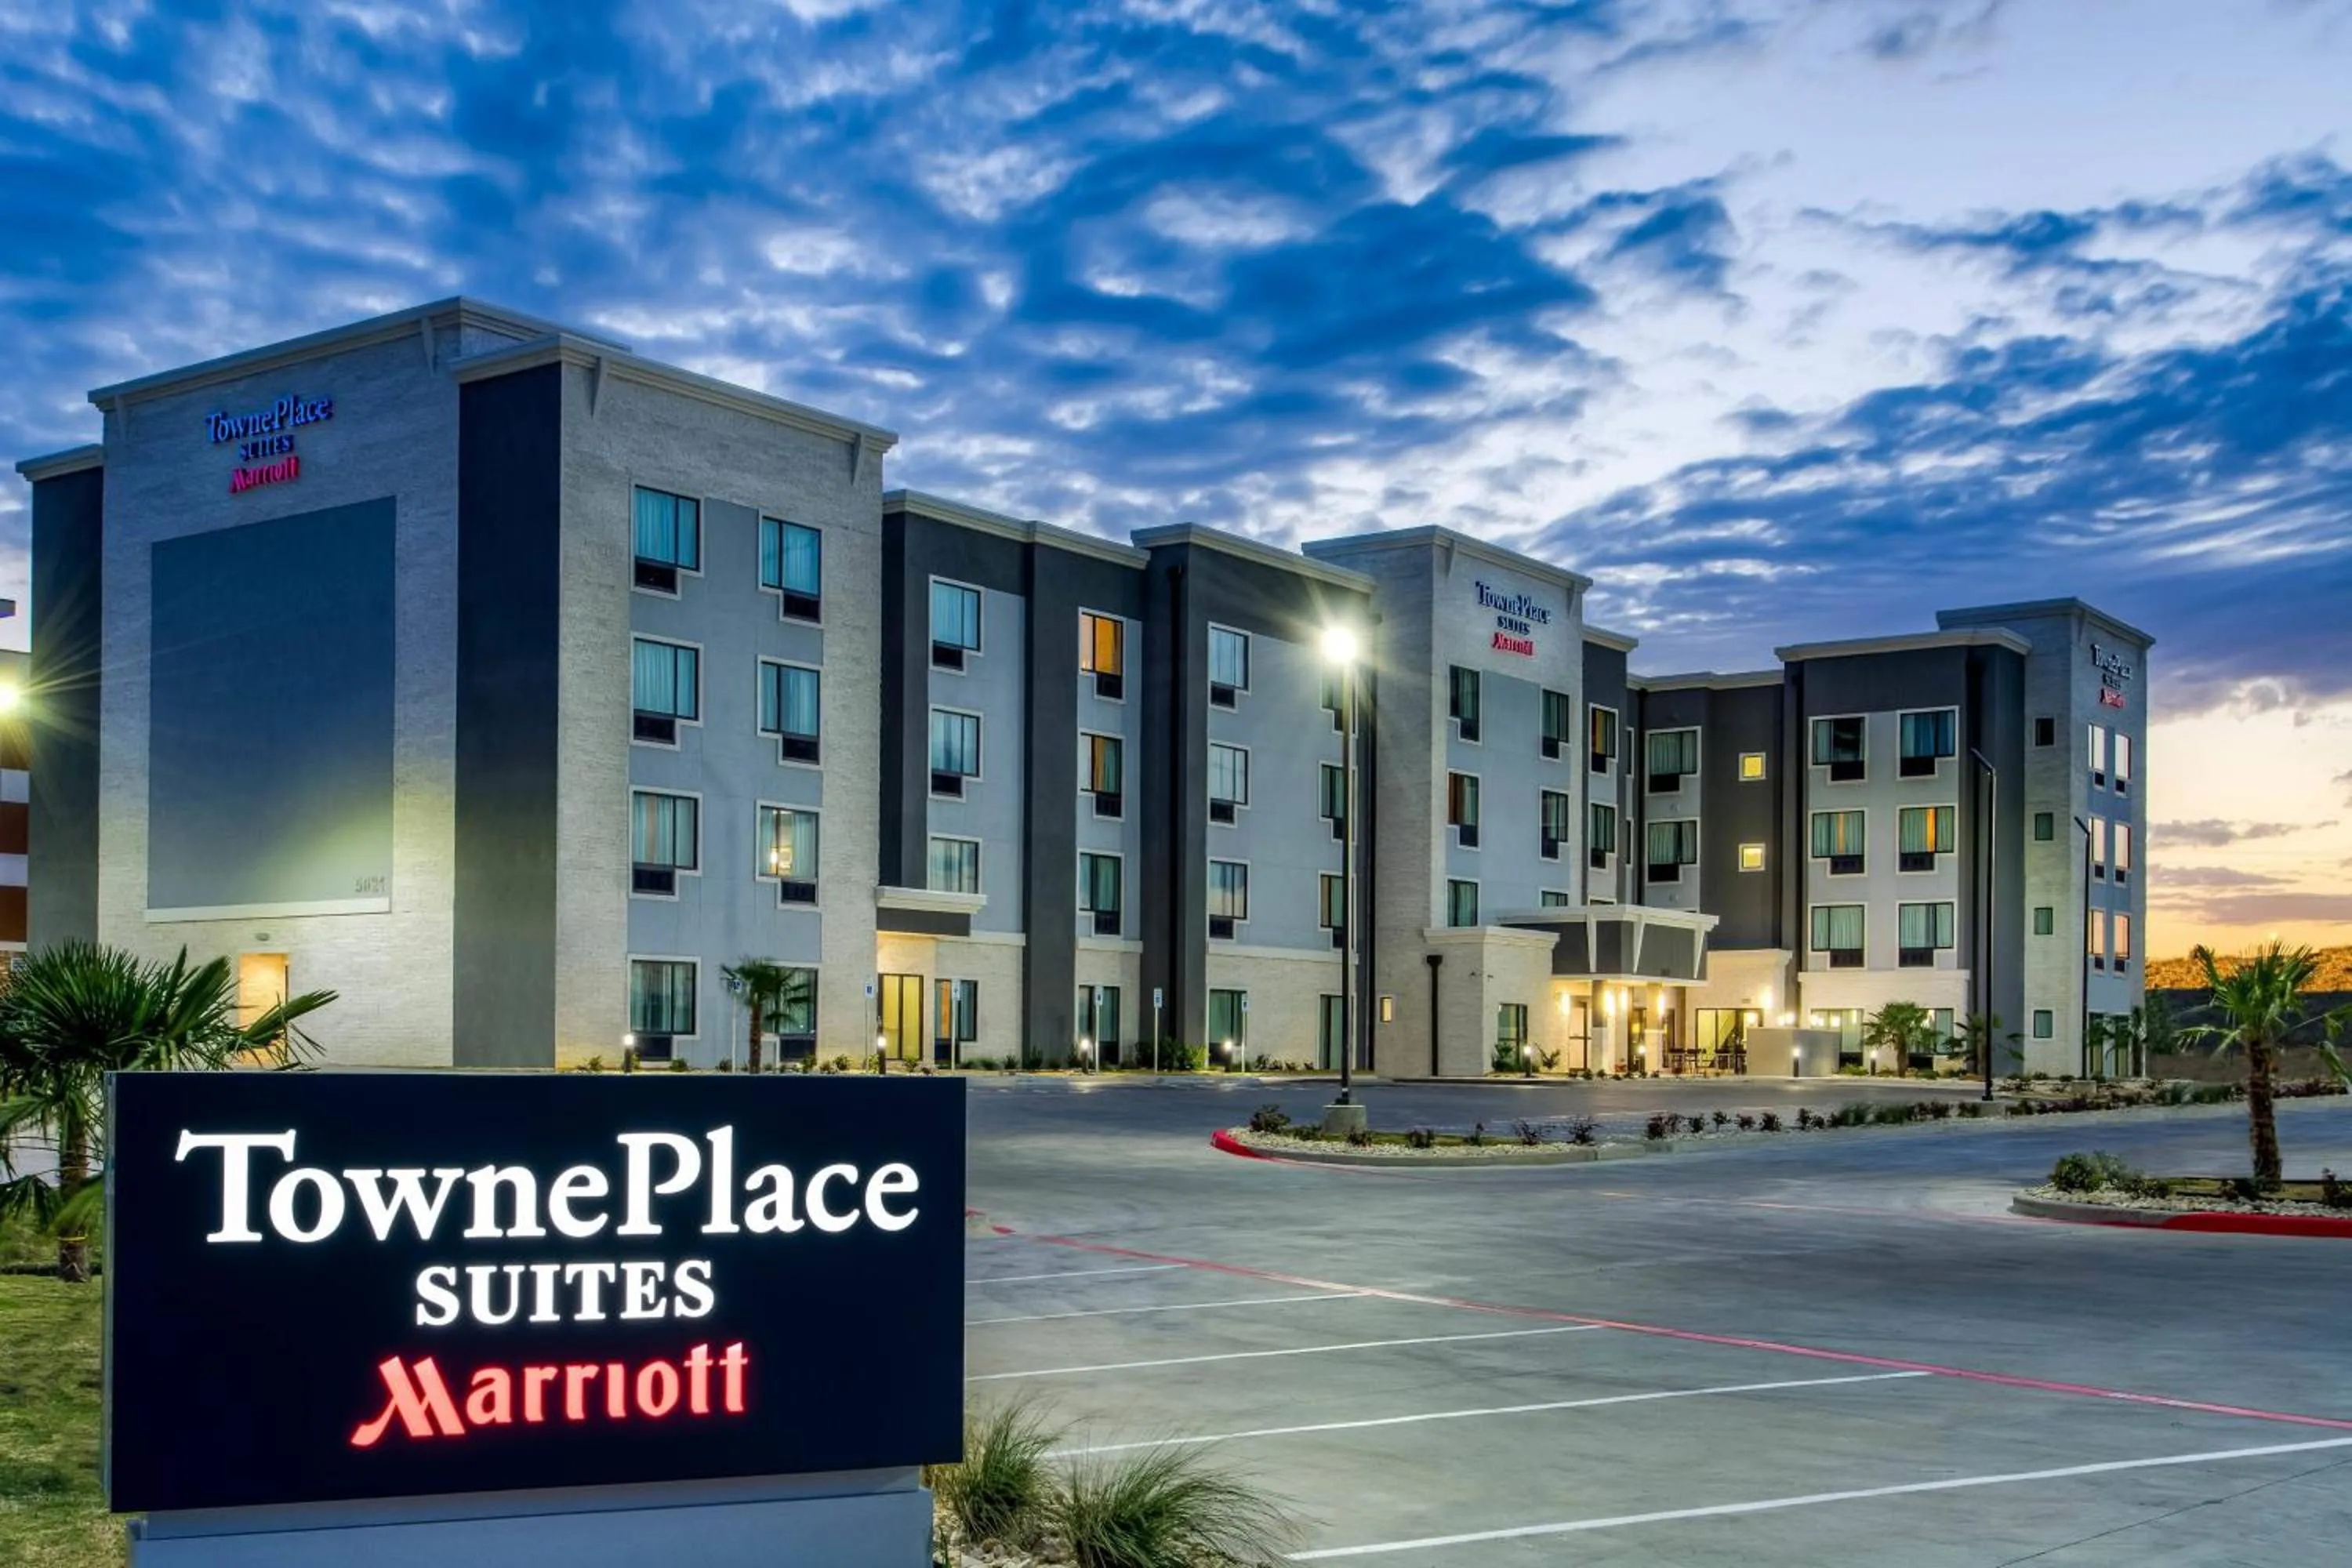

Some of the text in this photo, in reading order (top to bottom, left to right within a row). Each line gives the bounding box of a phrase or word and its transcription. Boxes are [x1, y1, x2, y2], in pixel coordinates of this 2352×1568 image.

[205, 395, 334, 443] TownePlace
[229, 456, 299, 494] Marriott
[1475, 581, 1552, 624] TownePlace
[1491, 632, 1534, 655] Marriott
[175, 1124, 920, 1243] TownePlace
[415, 1259, 715, 1327] SUITES
[350, 1341, 750, 1447] Marriott
